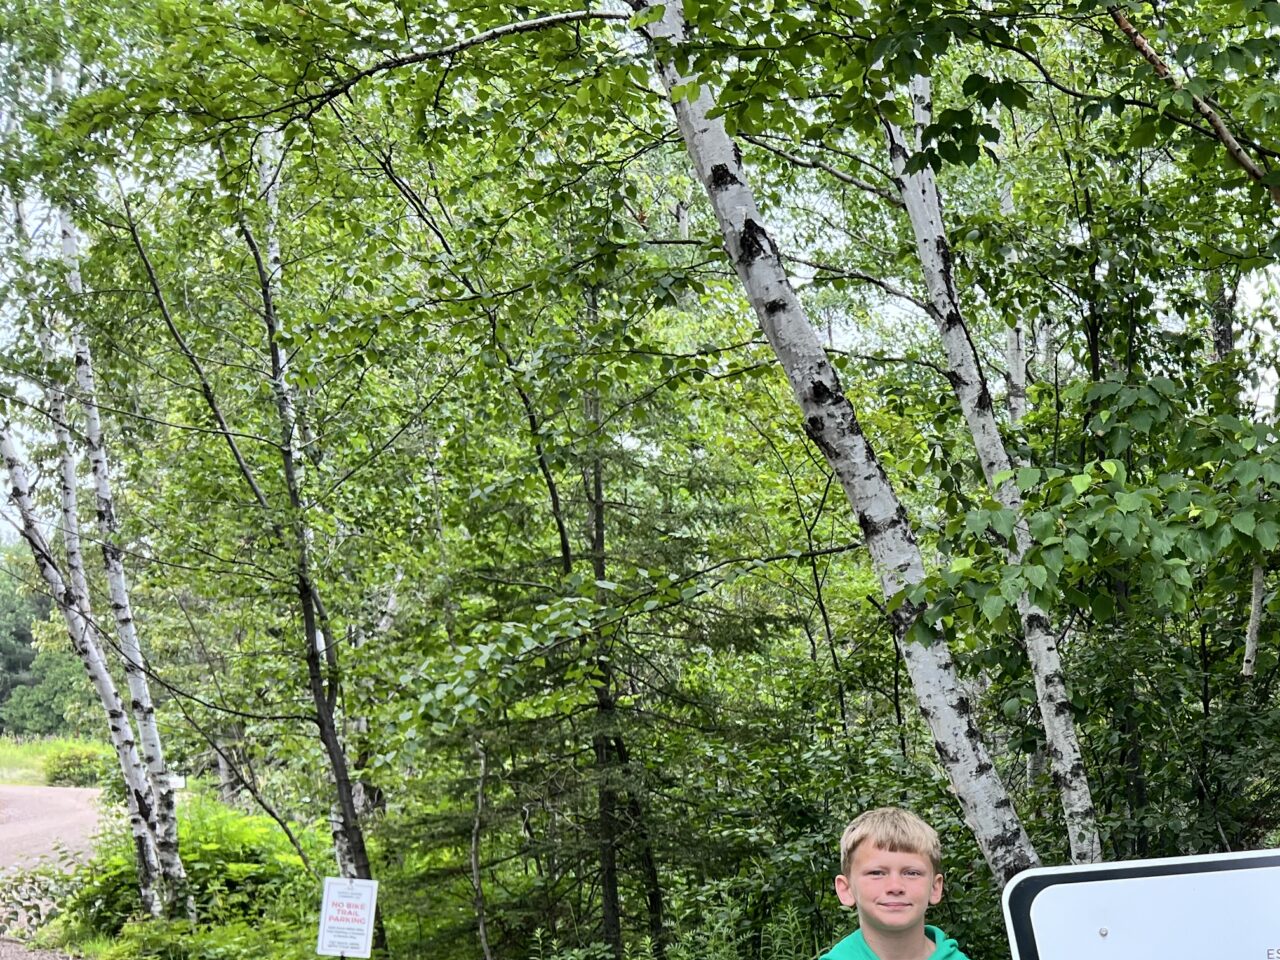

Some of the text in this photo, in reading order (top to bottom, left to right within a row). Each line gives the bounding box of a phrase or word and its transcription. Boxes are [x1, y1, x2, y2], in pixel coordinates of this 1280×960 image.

[331, 901, 366, 910] NO BIKE
[336, 909, 360, 917] TRAIL
[328, 915, 366, 925] PARKING
